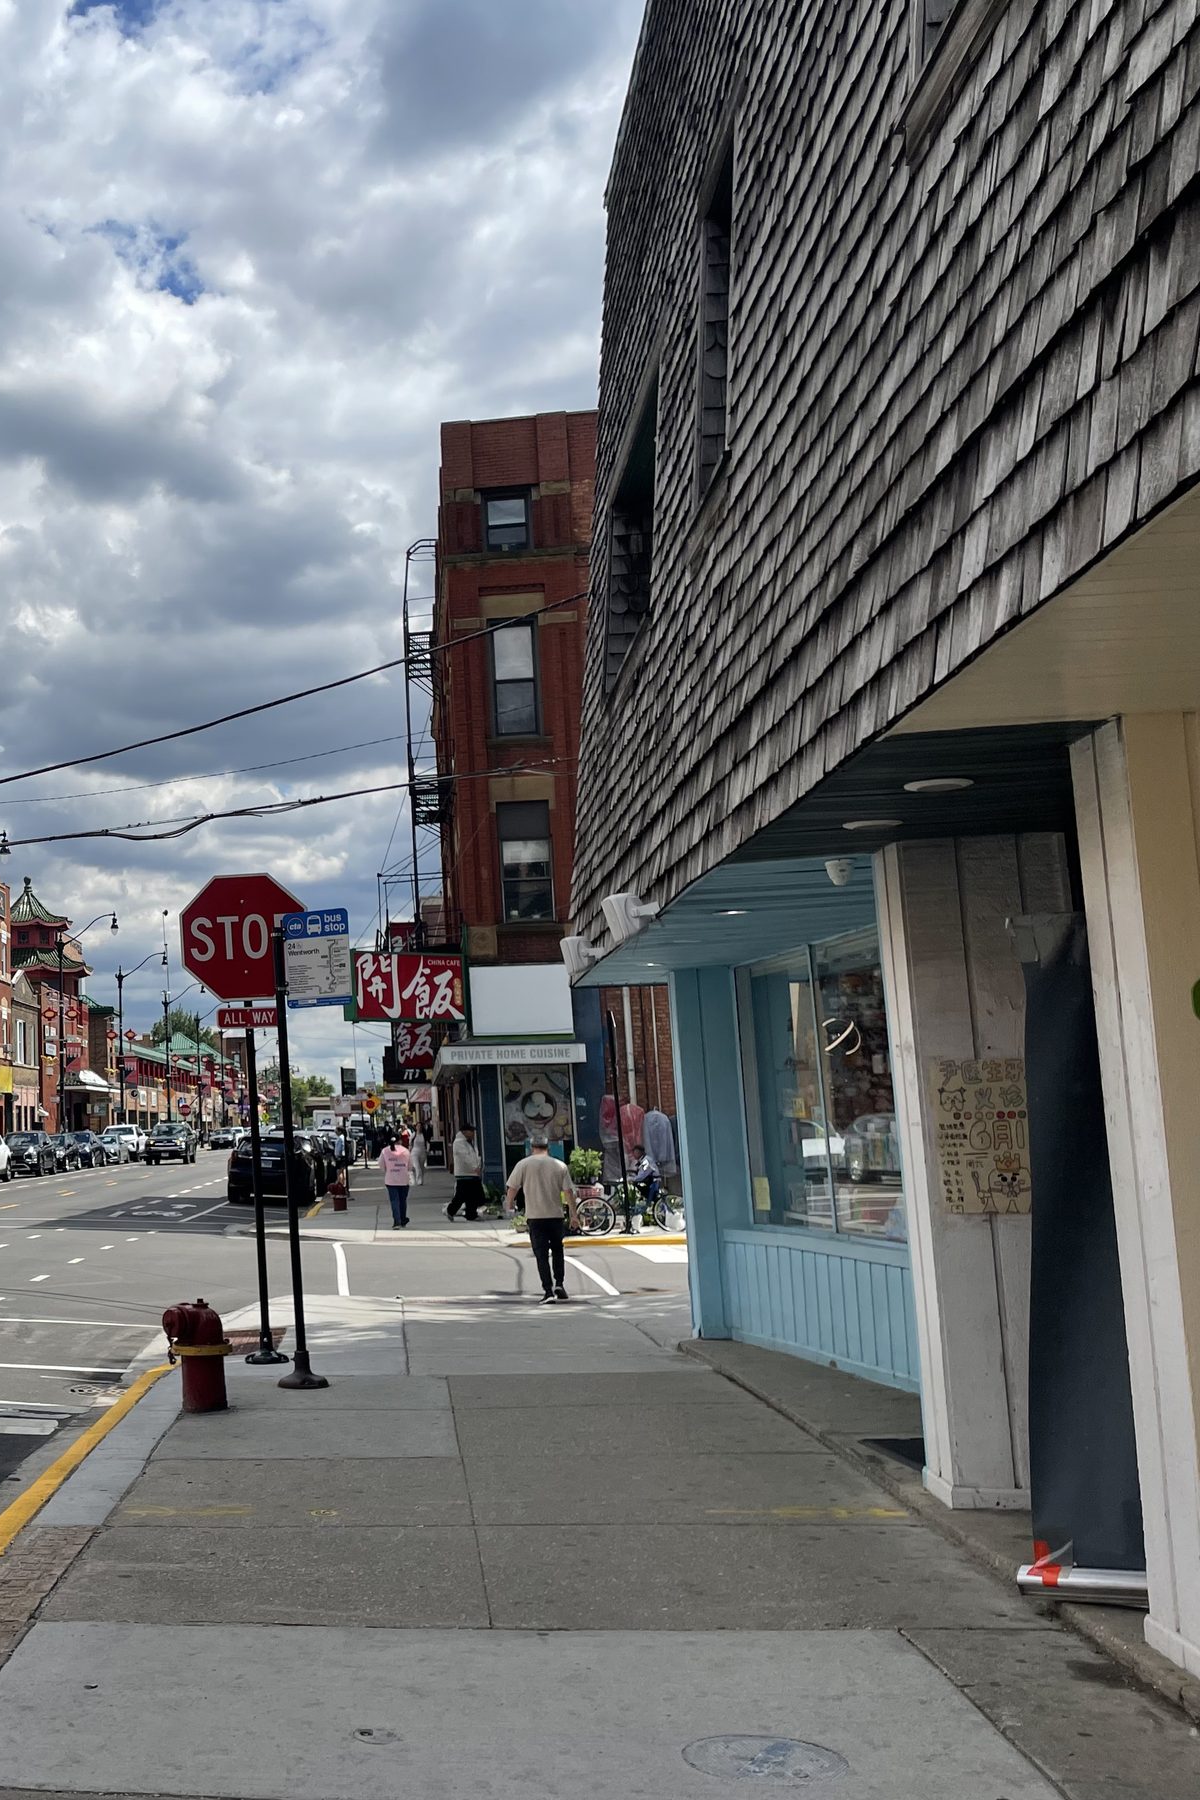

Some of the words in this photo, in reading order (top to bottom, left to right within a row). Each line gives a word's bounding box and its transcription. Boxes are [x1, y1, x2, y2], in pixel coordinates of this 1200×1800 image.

[323, 913, 342, 923] bus
[289, 922, 302, 931] cta
[324, 922, 346, 933] stop
[190, 913, 283, 962] STO
[287, 943, 296, 951] 24
[288, 949, 320, 957] Wentworth
[446, 959, 461, 967] CAFE
[223, 1012, 246, 1025] ALL
[252, 1011, 275, 1024] WAY
[450, 1049, 493, 1061] PRIVATE
[496, 1049, 526, 1060] HOME
[529, 1048, 571, 1059] CUISINE
